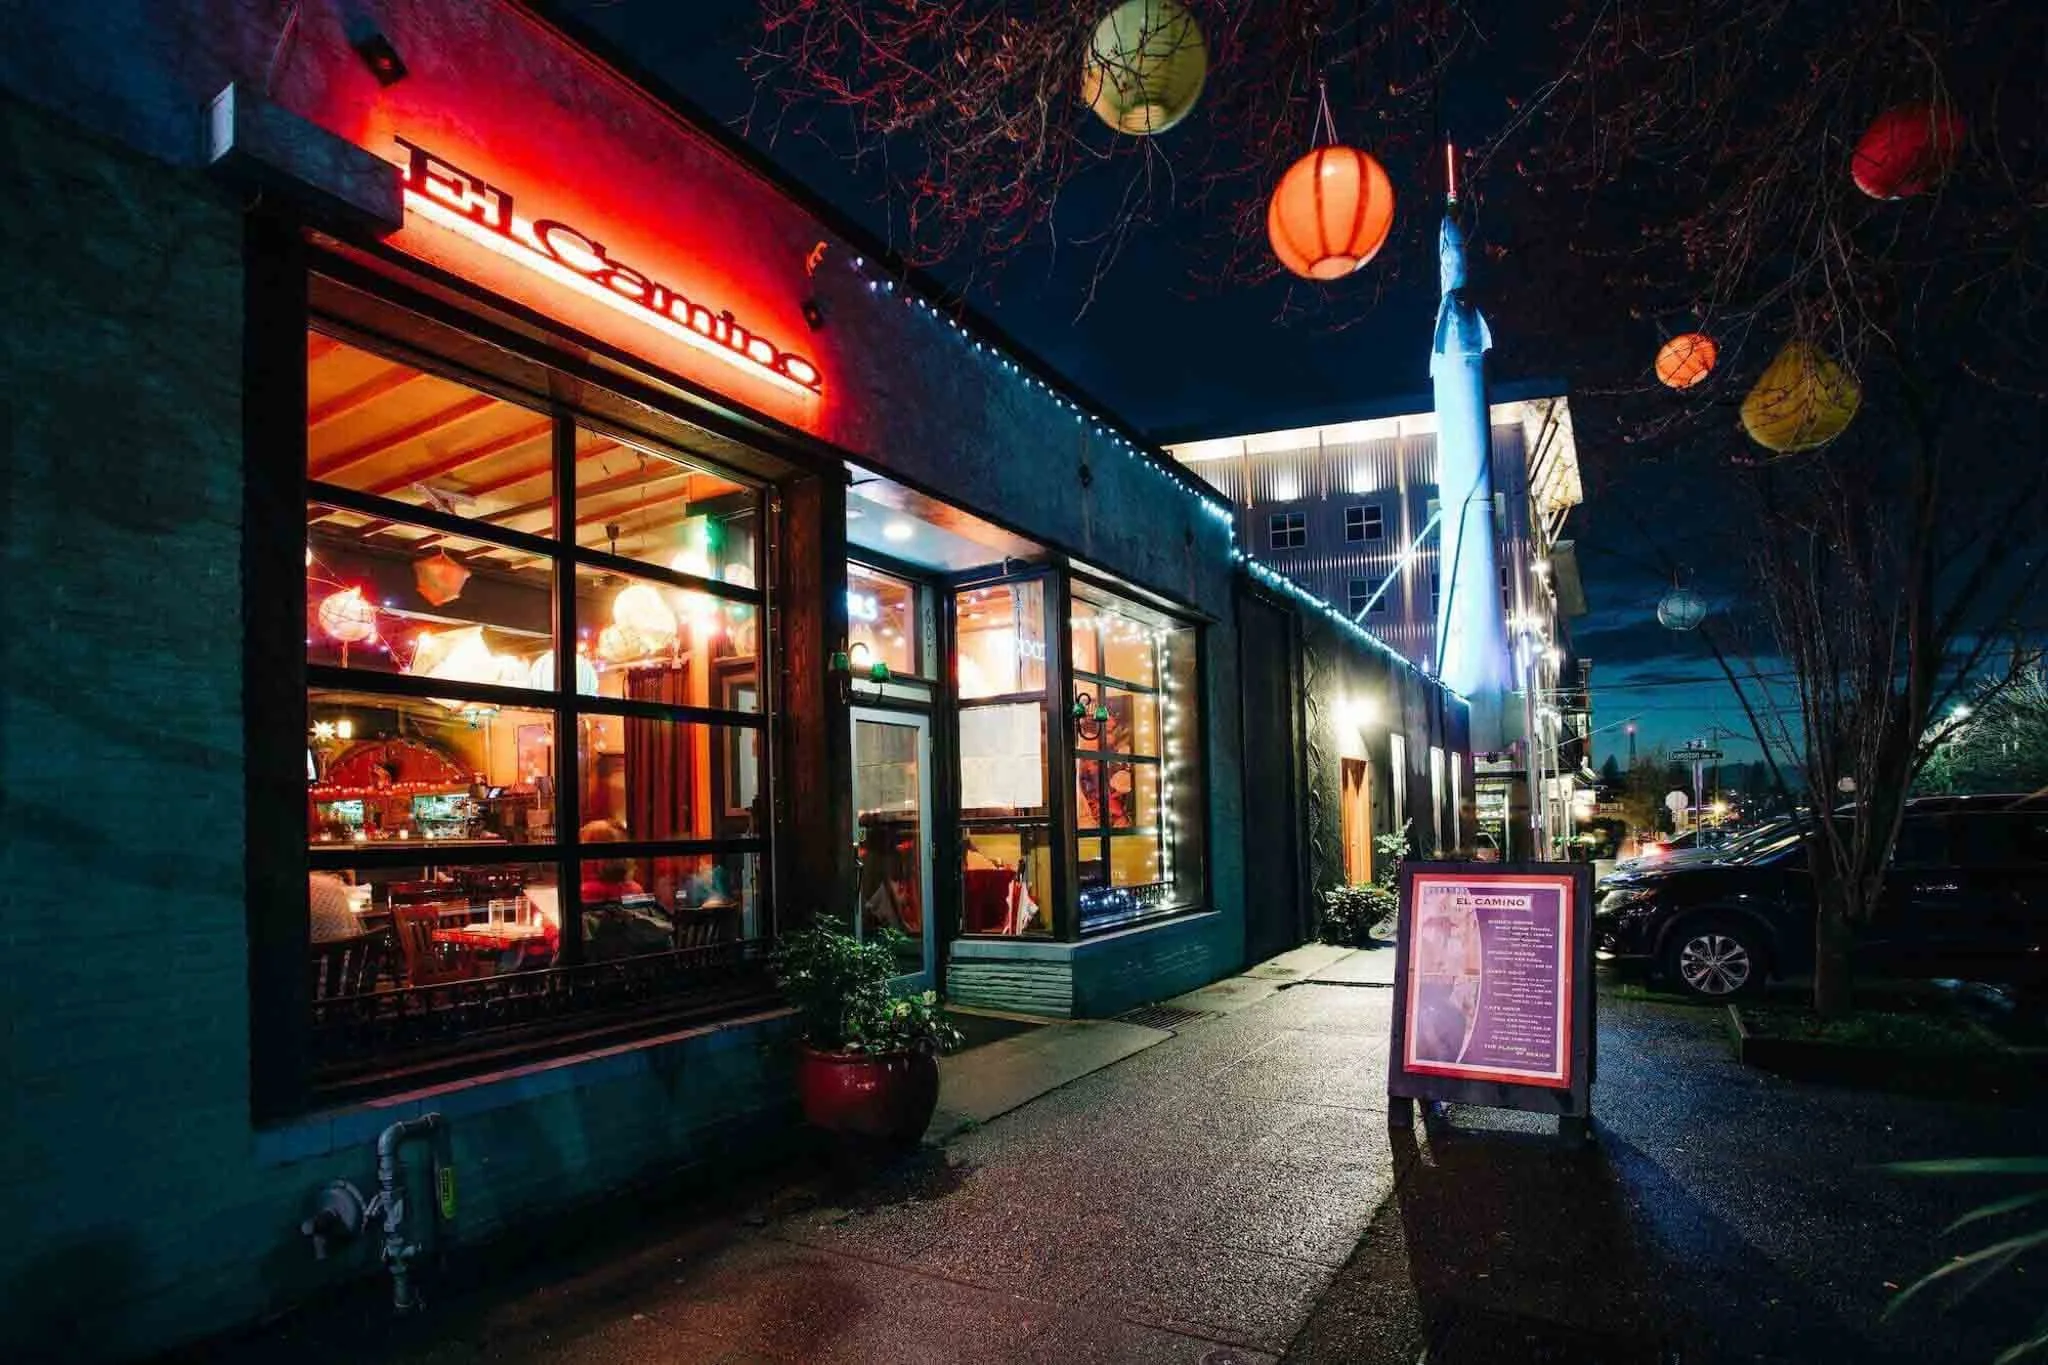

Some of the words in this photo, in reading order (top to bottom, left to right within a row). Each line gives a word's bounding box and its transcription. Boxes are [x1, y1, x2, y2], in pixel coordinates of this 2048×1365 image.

[393, 134, 518, 240] El
[532, 218, 824, 391] Camino
[1456, 897, 1472, 905] EL
[1474, 898, 1525, 906] CAMINO
